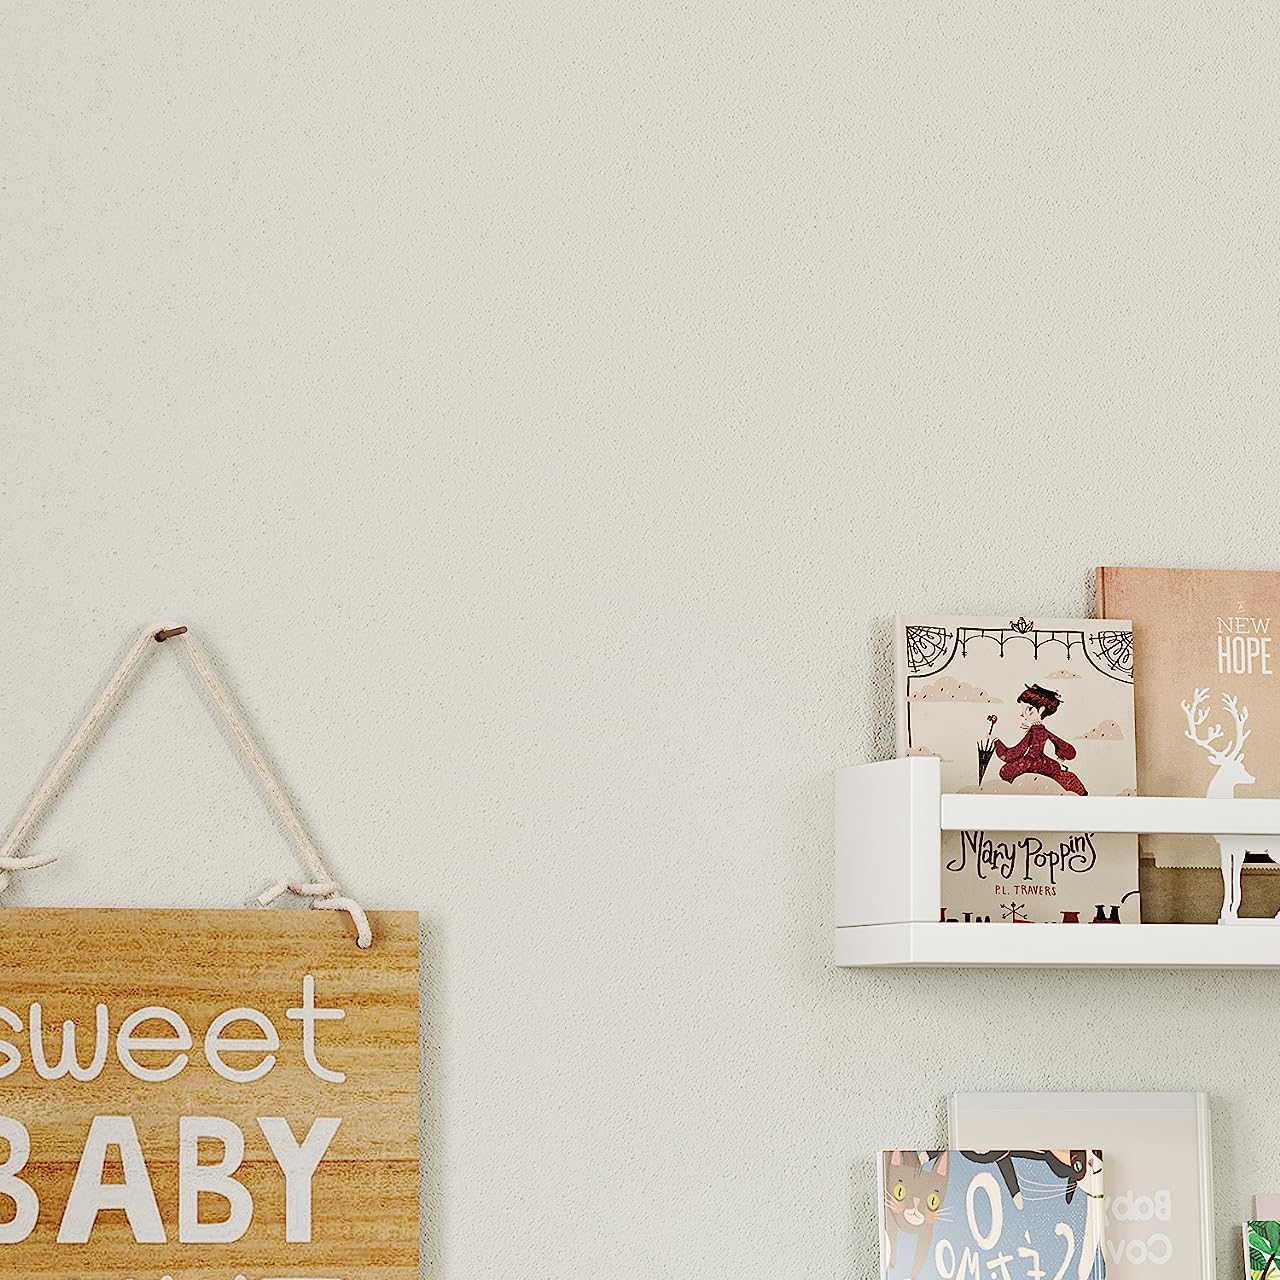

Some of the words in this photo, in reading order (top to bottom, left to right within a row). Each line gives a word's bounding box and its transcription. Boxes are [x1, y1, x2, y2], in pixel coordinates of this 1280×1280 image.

[1217, 616, 1272, 634] NEW
[1217, 635, 1273, 675] HOPE
[946, 831, 1016, 879] Mary
[1018, 832, 1097, 884] Poppins
[1014, 885, 1057, 896] TRAVERS
[0, 975, 346, 1083] sweet
[0, 1116, 342, 1244] BABY
